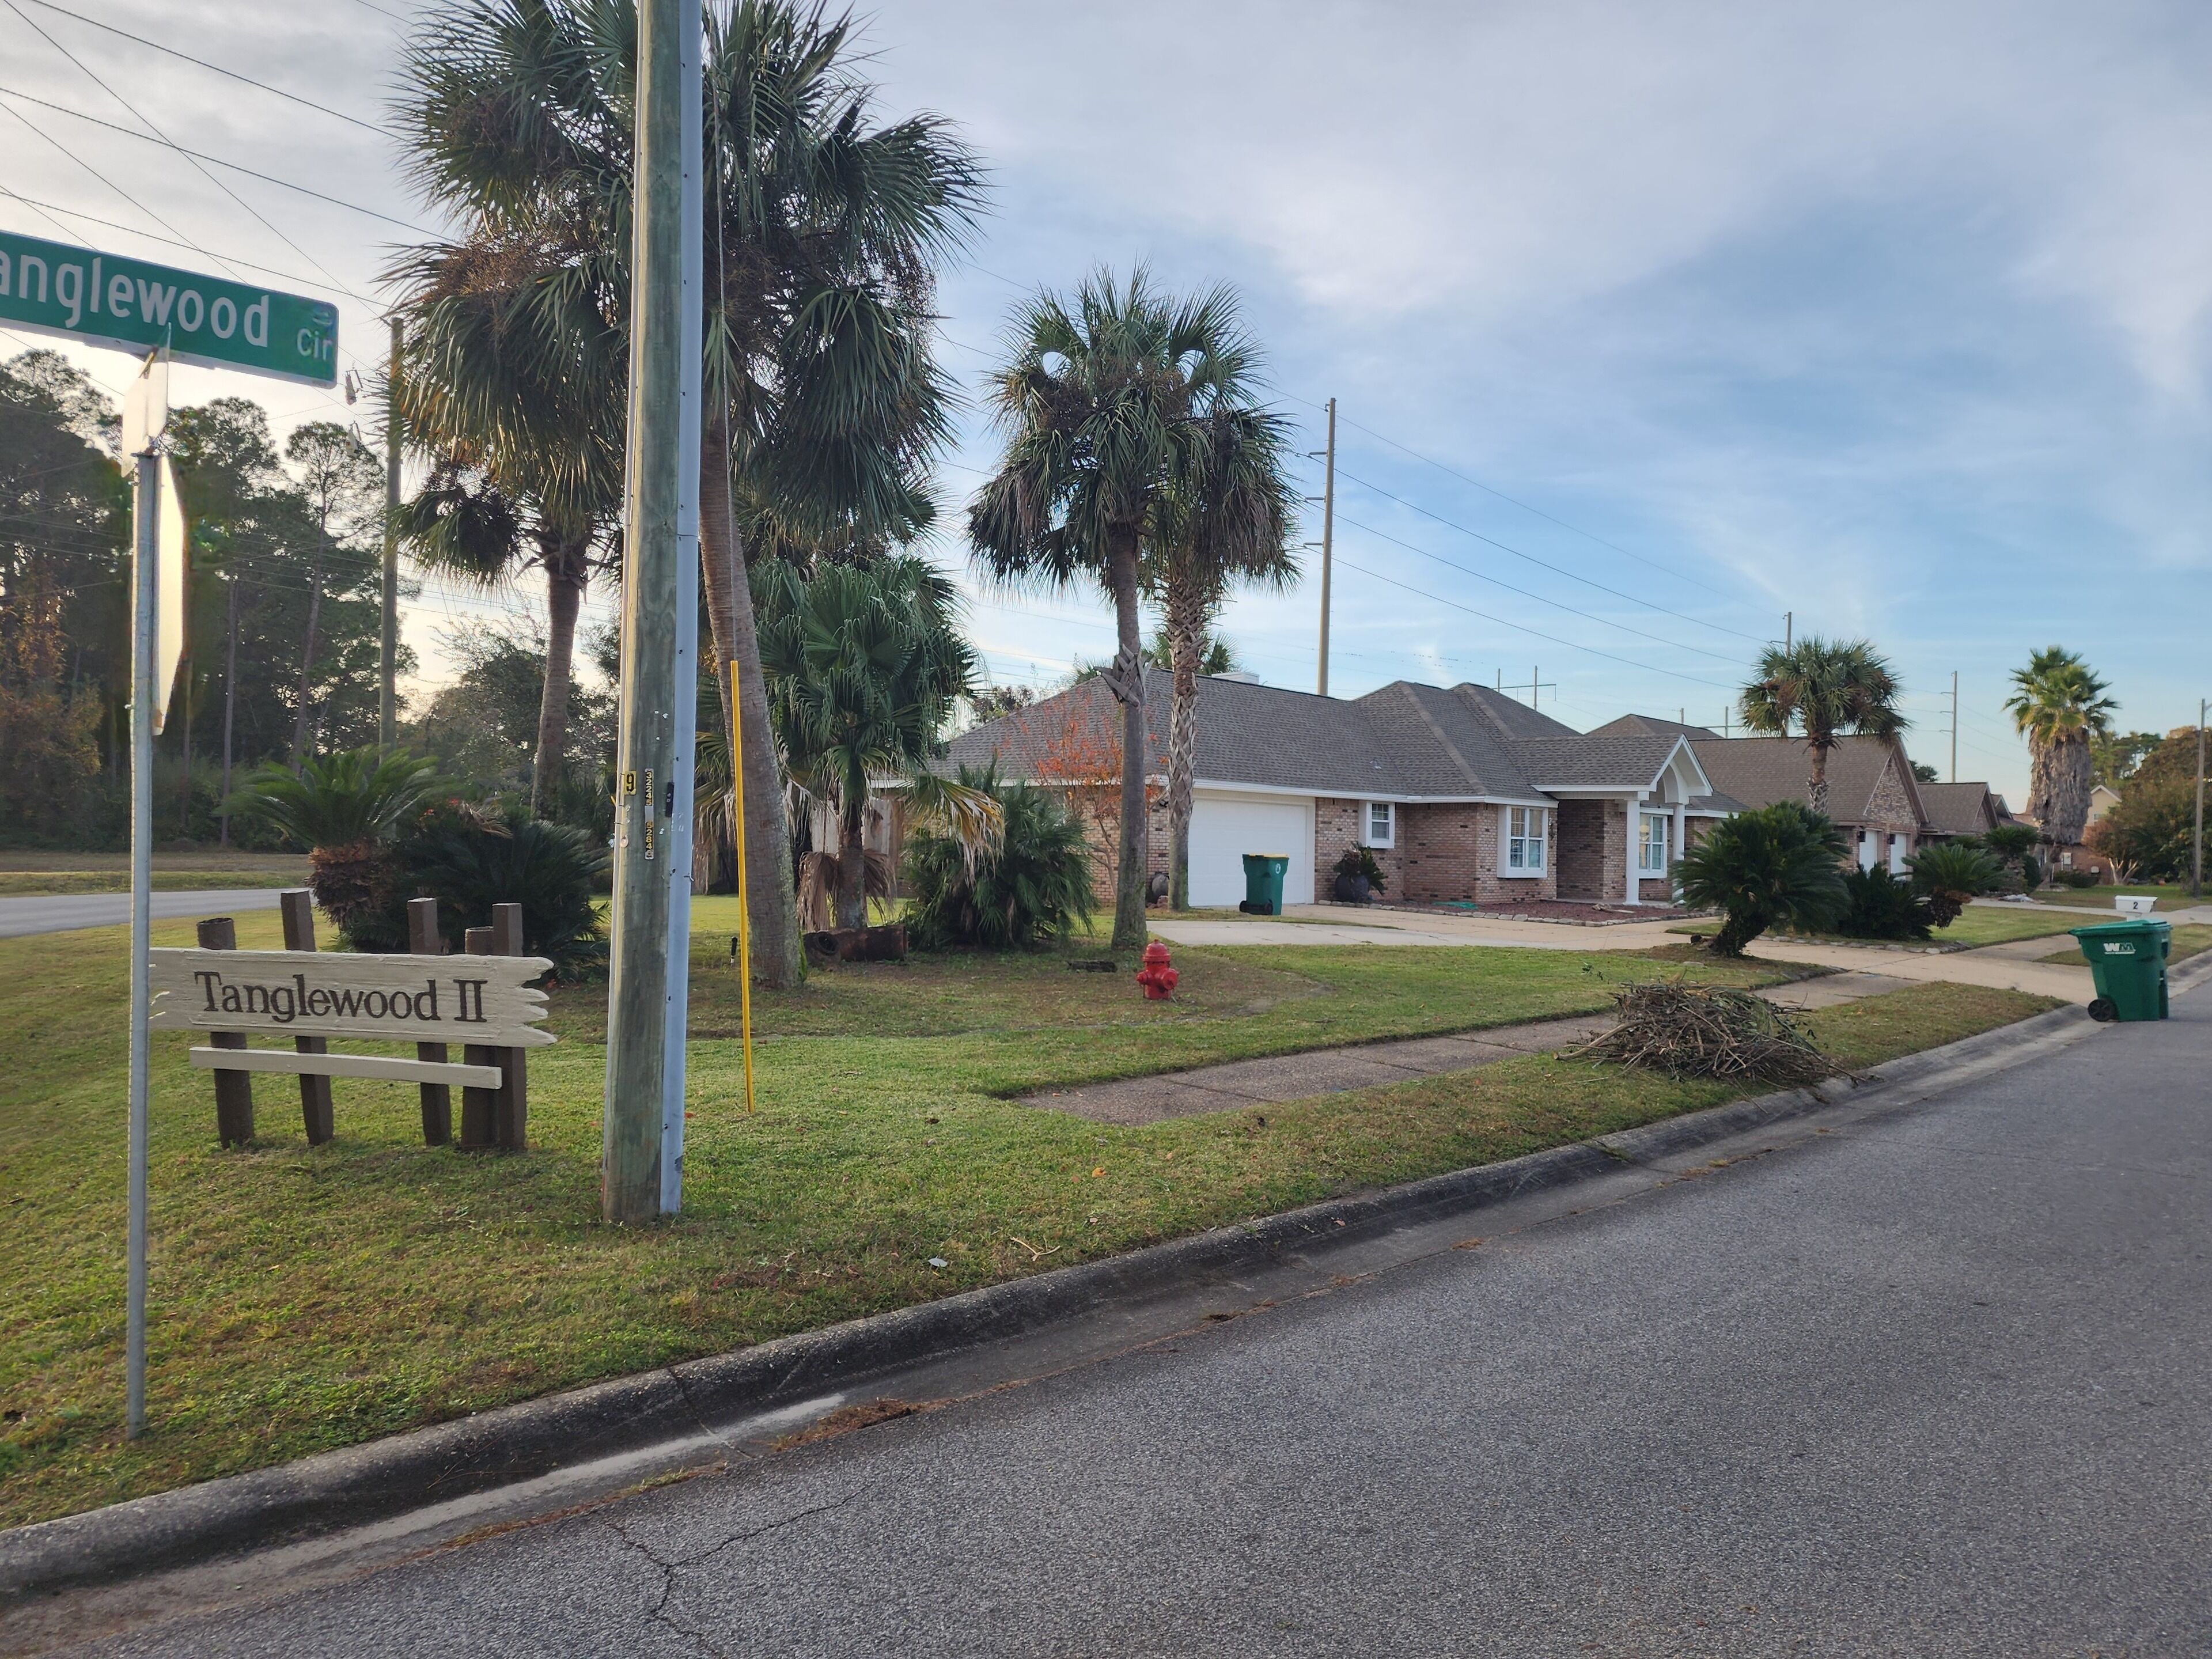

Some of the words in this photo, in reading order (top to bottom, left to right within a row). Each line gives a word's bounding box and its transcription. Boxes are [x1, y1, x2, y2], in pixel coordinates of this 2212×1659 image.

[297, 328, 332, 361] Cir
[627, 774, 634, 792] 9
[2133, 902, 2138, 910] 2
[194, 971, 441, 1023] Tanglewood
[453, 979, 488, 1023] II
